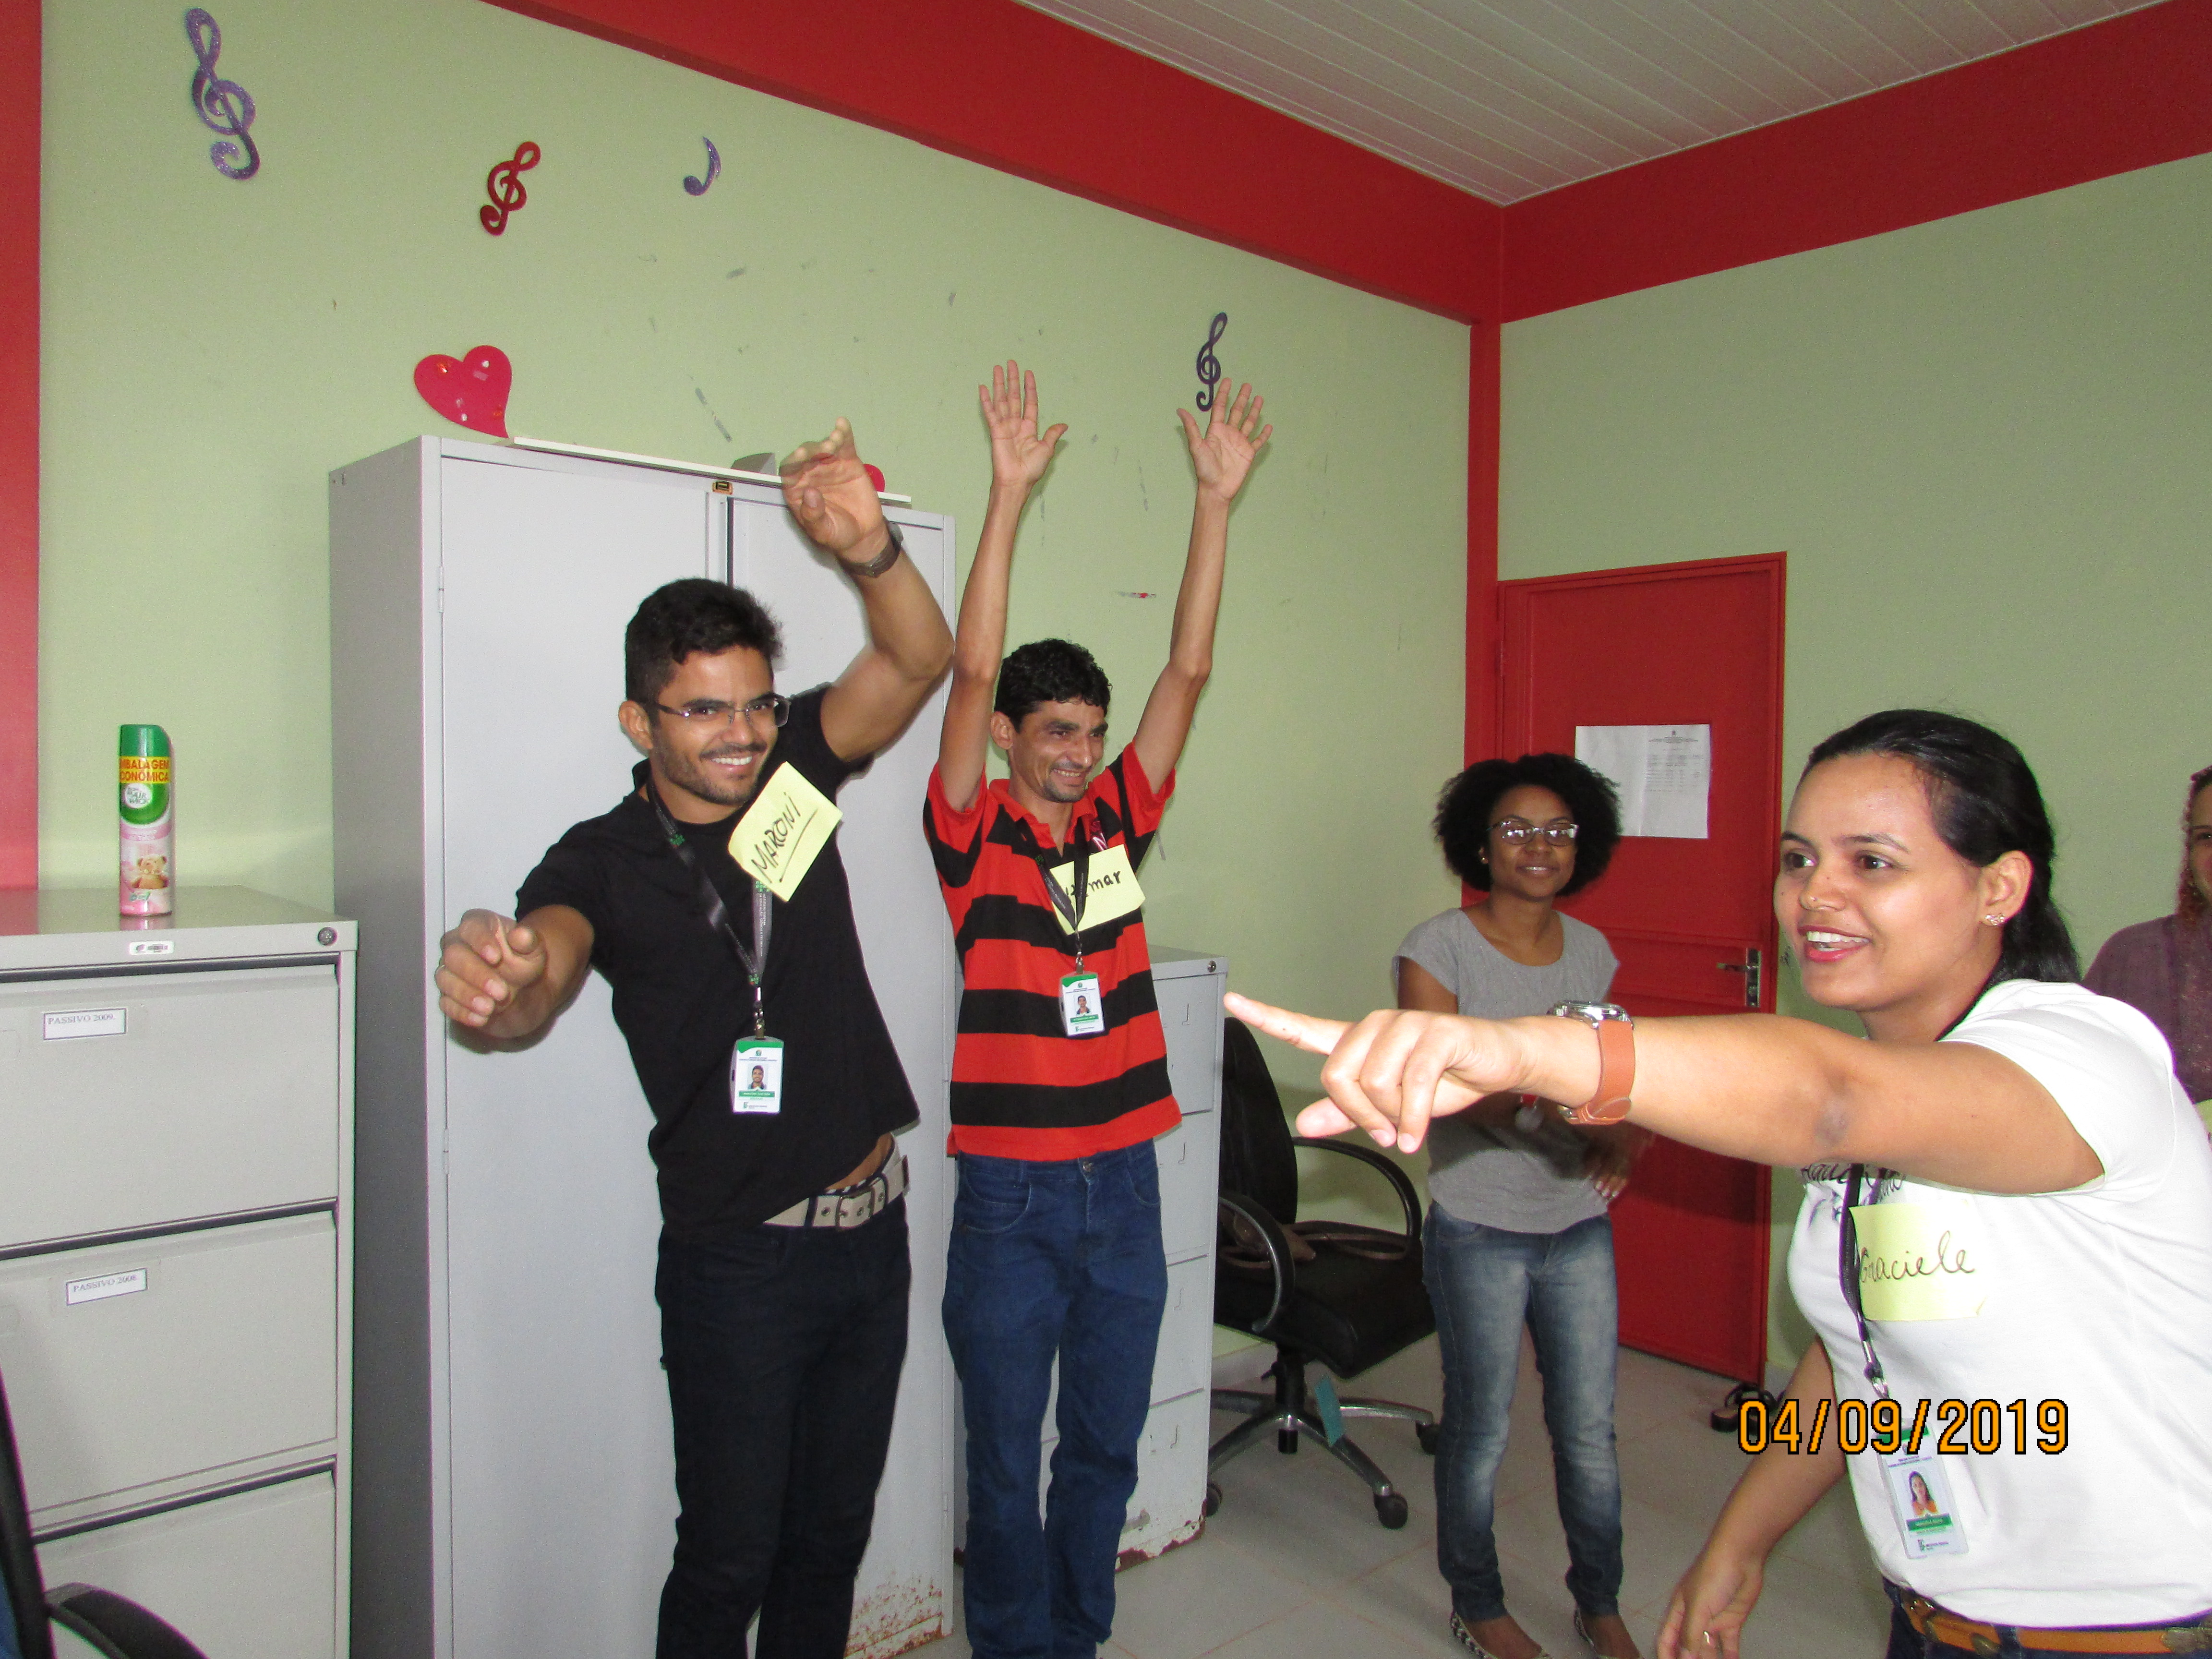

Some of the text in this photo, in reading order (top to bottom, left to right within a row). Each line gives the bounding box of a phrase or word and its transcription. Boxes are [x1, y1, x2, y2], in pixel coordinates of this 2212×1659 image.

[751, 792, 801, 884] MARONI
[48, 1015, 91, 1024] PASSIVO
[1860, 1230, 1976, 1283] Graciele
[73, 1278, 115, 1292] PASSIVO
